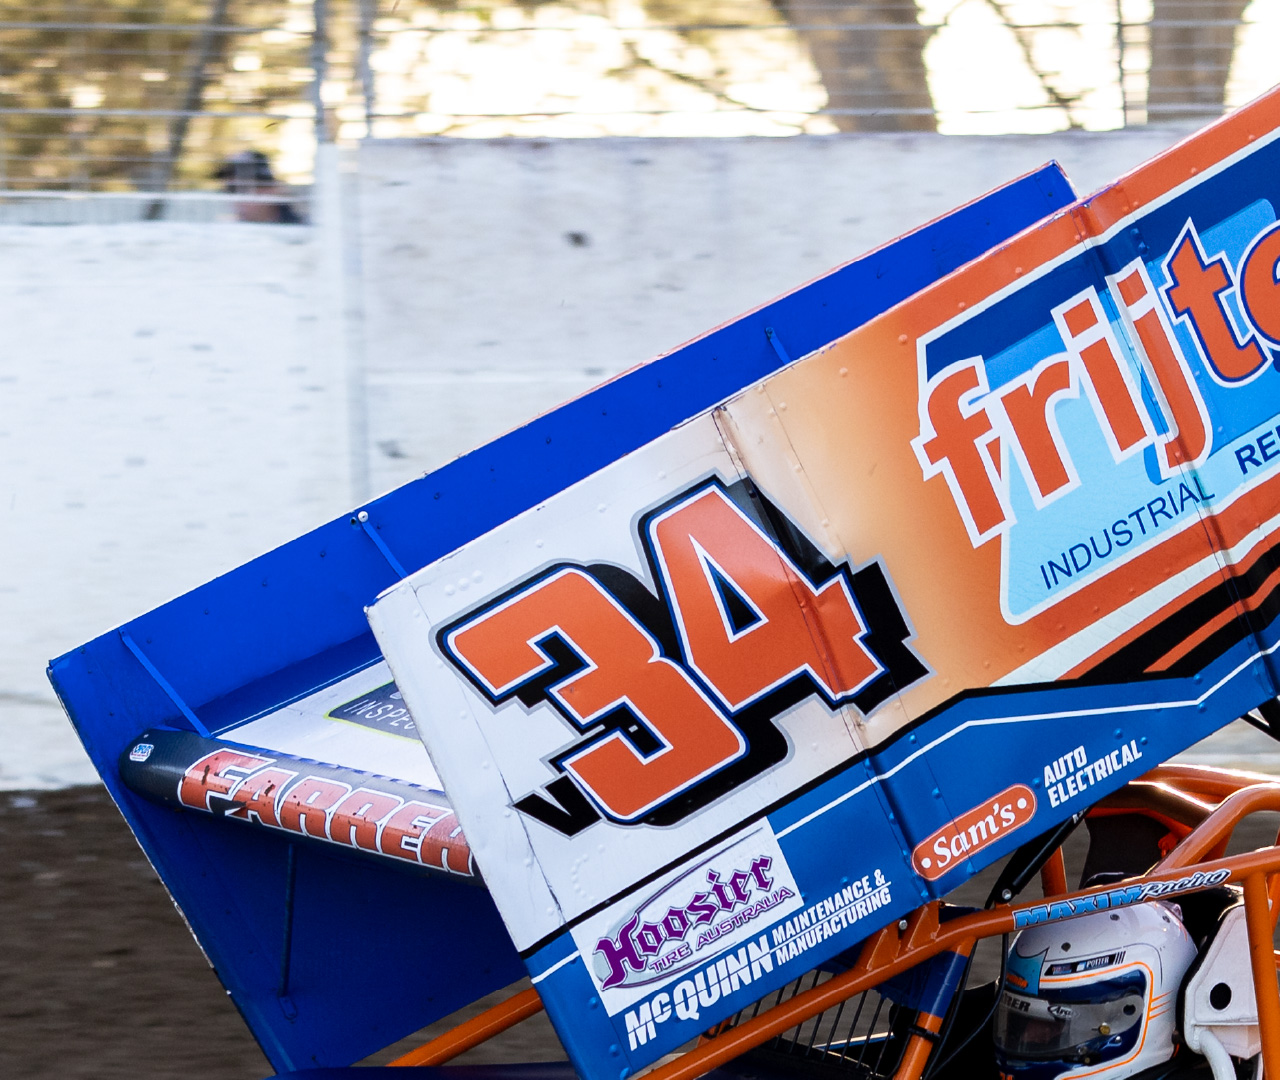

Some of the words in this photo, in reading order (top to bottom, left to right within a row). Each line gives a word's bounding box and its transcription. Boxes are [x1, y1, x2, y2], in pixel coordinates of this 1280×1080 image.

[1039, 477, 1215, 590] INDUSTRIAL
[440, 480, 890, 824] 34
[1043, 745, 1088, 788] AUTO
[1047, 740, 1143, 808] ELECTRICAL
[932, 802, 1017, 869] Sam's
[591, 854, 773, 991] Hoosier
[649, 942, 692, 974] TIRE
[696, 886, 795, 951] AUSTRALIA
[772, 876, 873, 944] MAINTENANCE
[873, 868, 887, 888] &
[775, 886, 892, 966] MANUFACTURING
[1014, 884, 1142, 930] MAXIM
